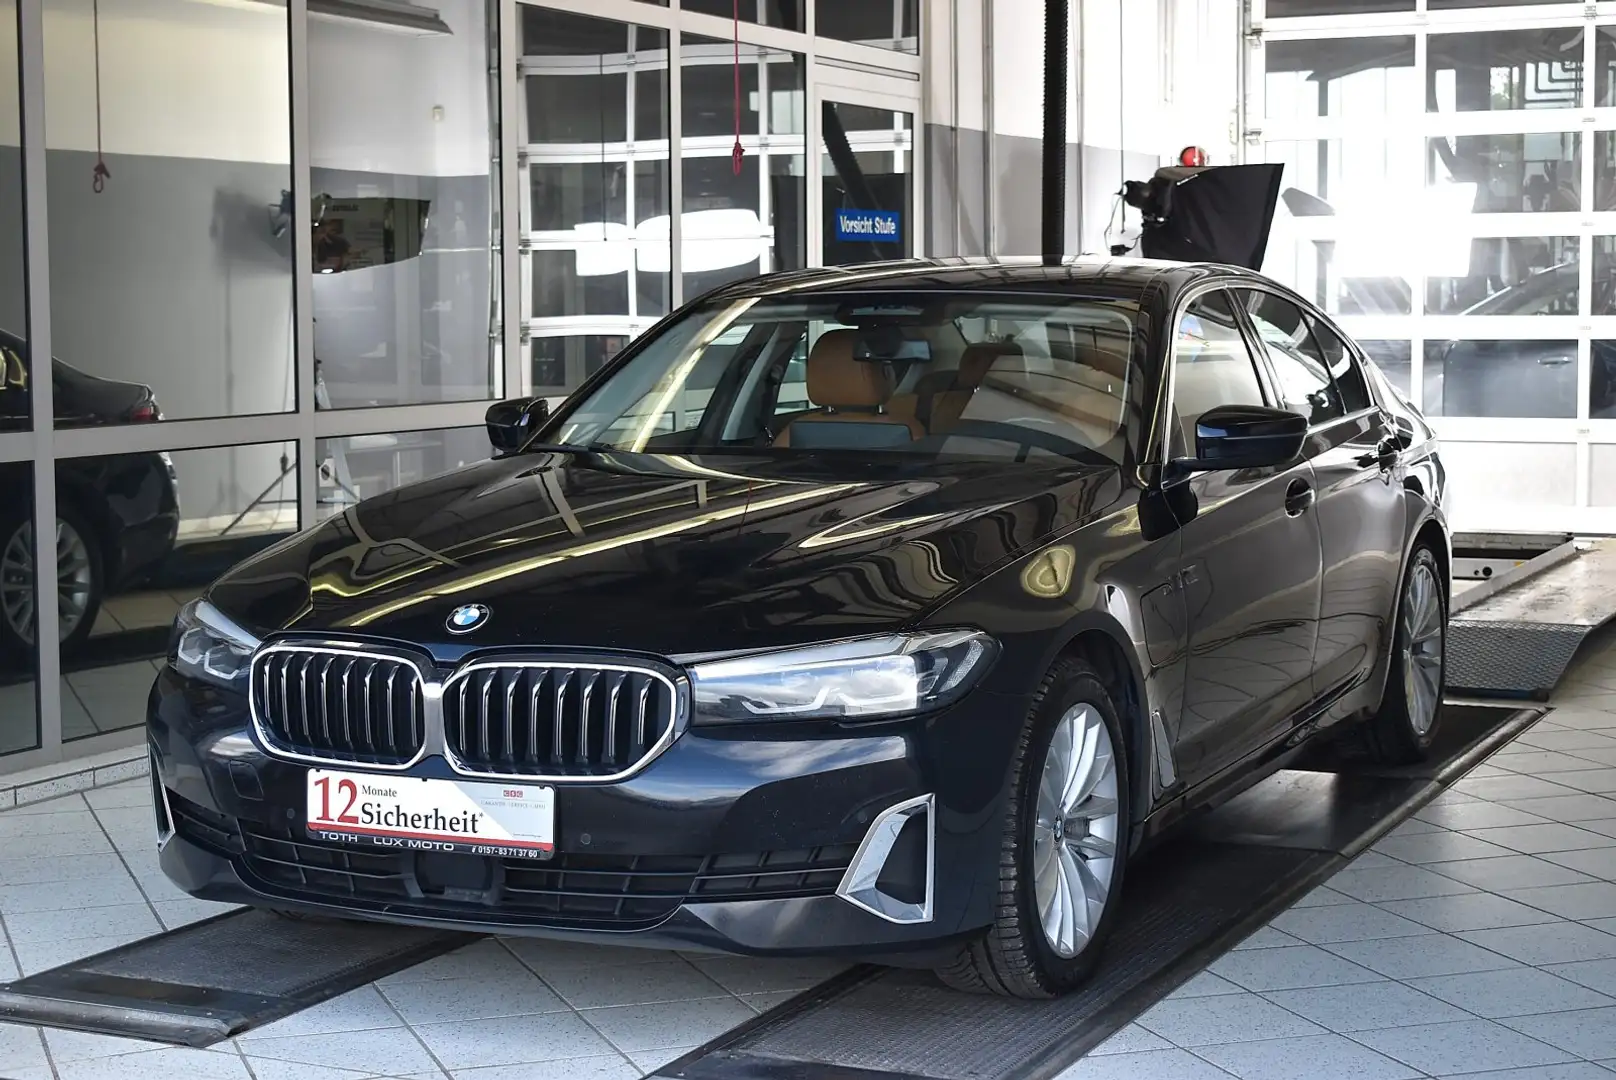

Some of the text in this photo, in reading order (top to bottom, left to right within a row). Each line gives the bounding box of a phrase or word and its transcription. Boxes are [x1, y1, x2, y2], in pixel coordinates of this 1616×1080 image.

[840, 215, 896, 235] Vorsicht Stufe
[314, 776, 360, 825] 12
[361, 785, 398, 798] Monate
[319, 831, 455, 851] TOTH LUX MOTO
